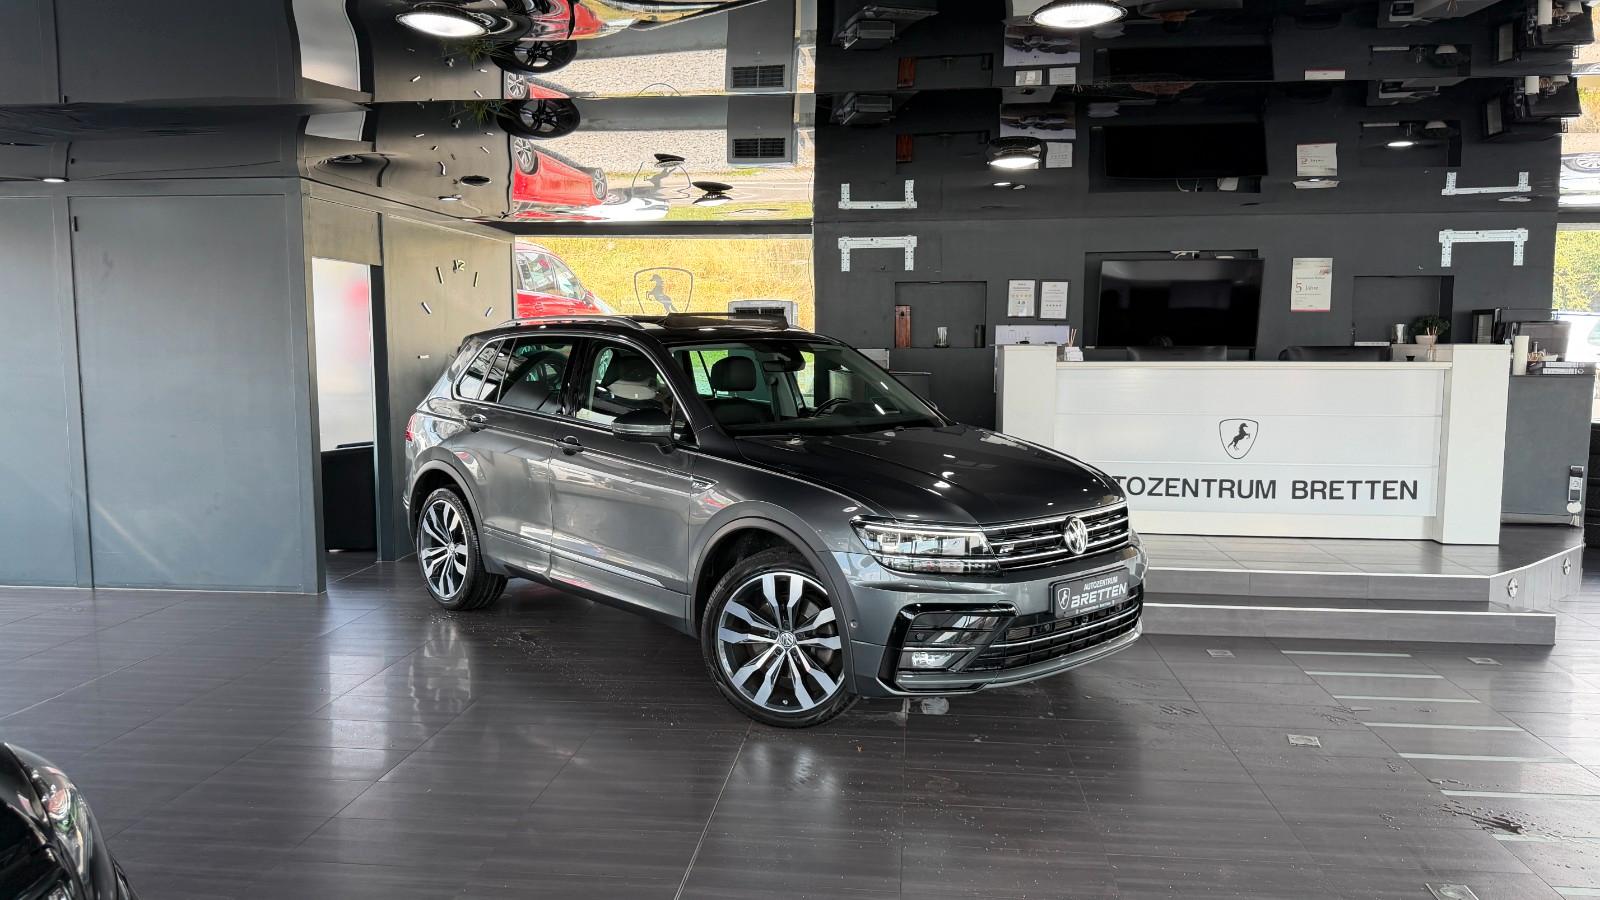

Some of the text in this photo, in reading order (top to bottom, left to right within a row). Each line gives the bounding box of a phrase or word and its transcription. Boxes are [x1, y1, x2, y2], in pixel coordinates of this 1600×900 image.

[1295, 282, 1303, 293] 5
[1111, 476, 1419, 501] TOZENTRUM BRETTEN
[1083, 575, 1119, 591] AUTOZENTRUM
[1070, 582, 1128, 608] BRETTEN
